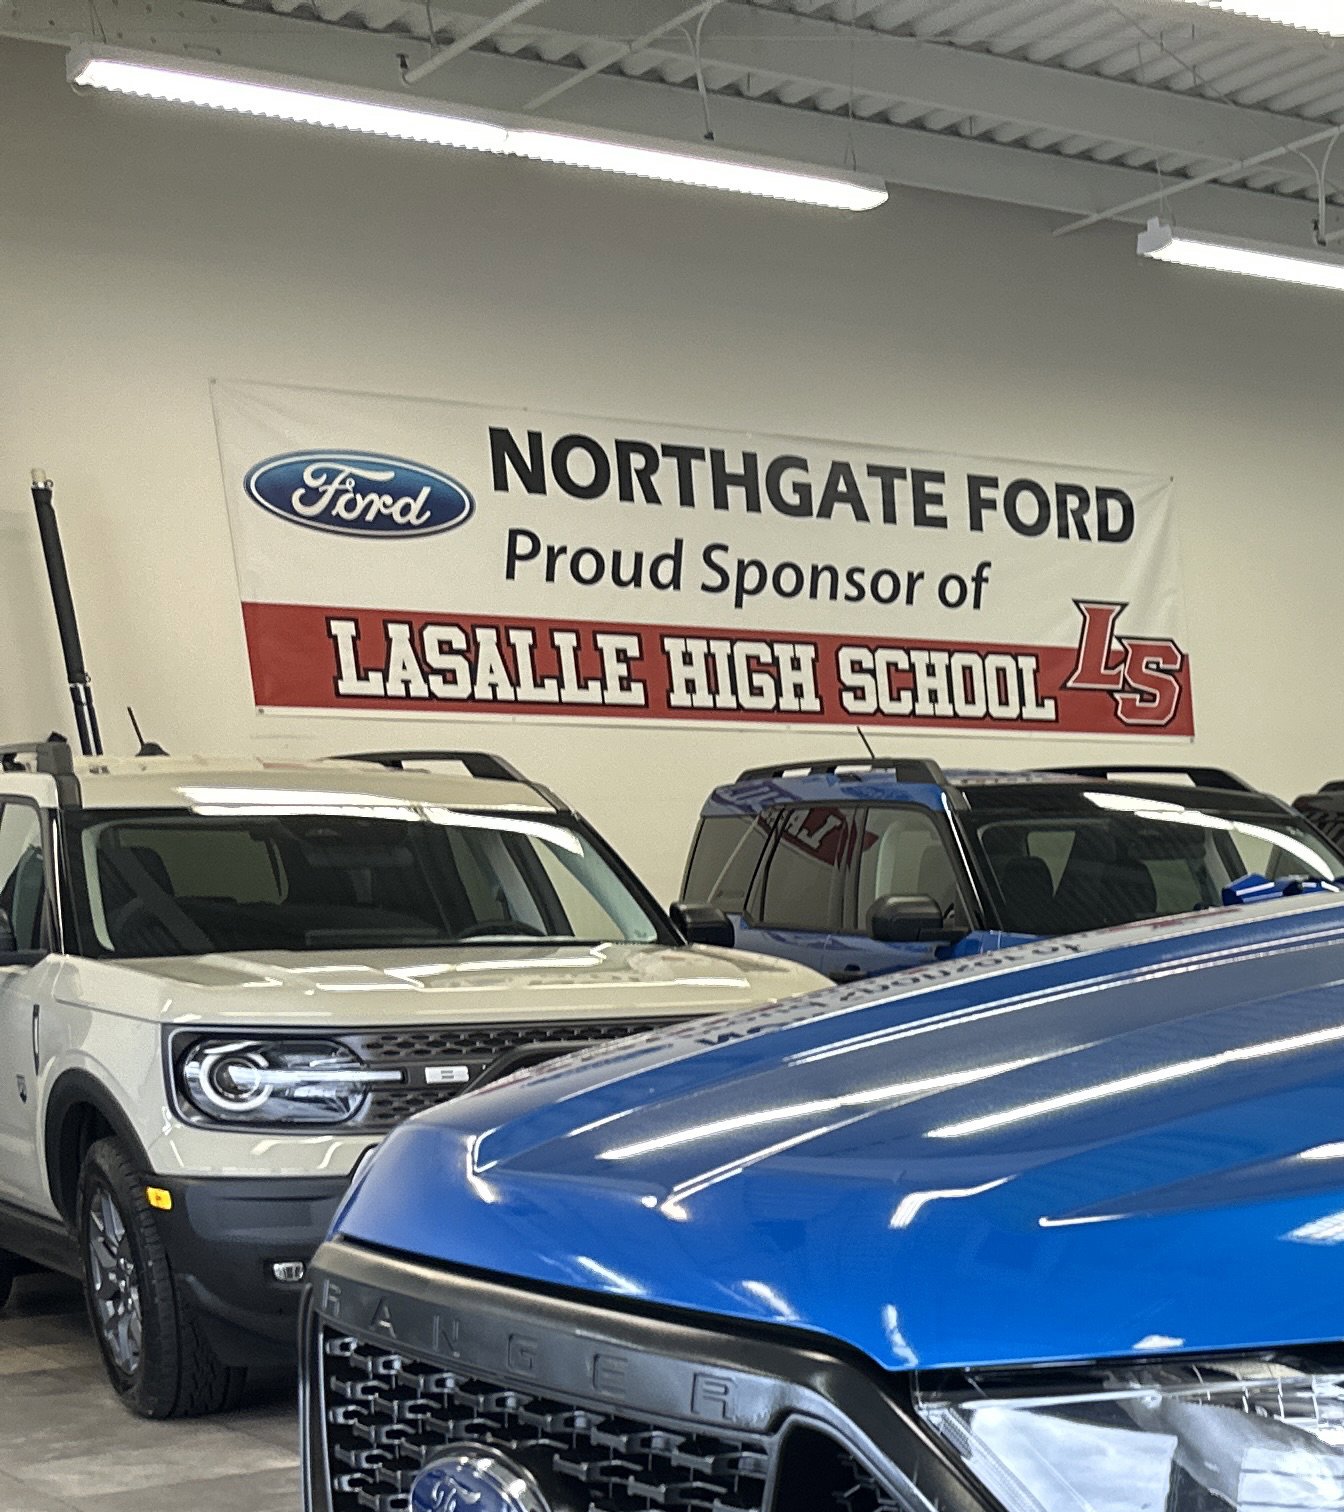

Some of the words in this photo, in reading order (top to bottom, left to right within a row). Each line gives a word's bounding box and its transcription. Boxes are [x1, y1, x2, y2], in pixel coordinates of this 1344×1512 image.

[291, 461, 432, 526] Ford
[488, 426, 948, 529] NORTHGATE
[966, 473, 1135, 543] FORD
[505, 528, 684, 591] Proud
[700, 541, 925, 609] Sponsor
[937, 561, 992, 610] of
[326, 616, 649, 708] LASALLE
[660, 634, 824, 714] HIGH
[835, 644, 1059, 723] SCHOOL
[1061, 598, 1183, 727] LS
[321, 1279, 738, 1421] RANGER
